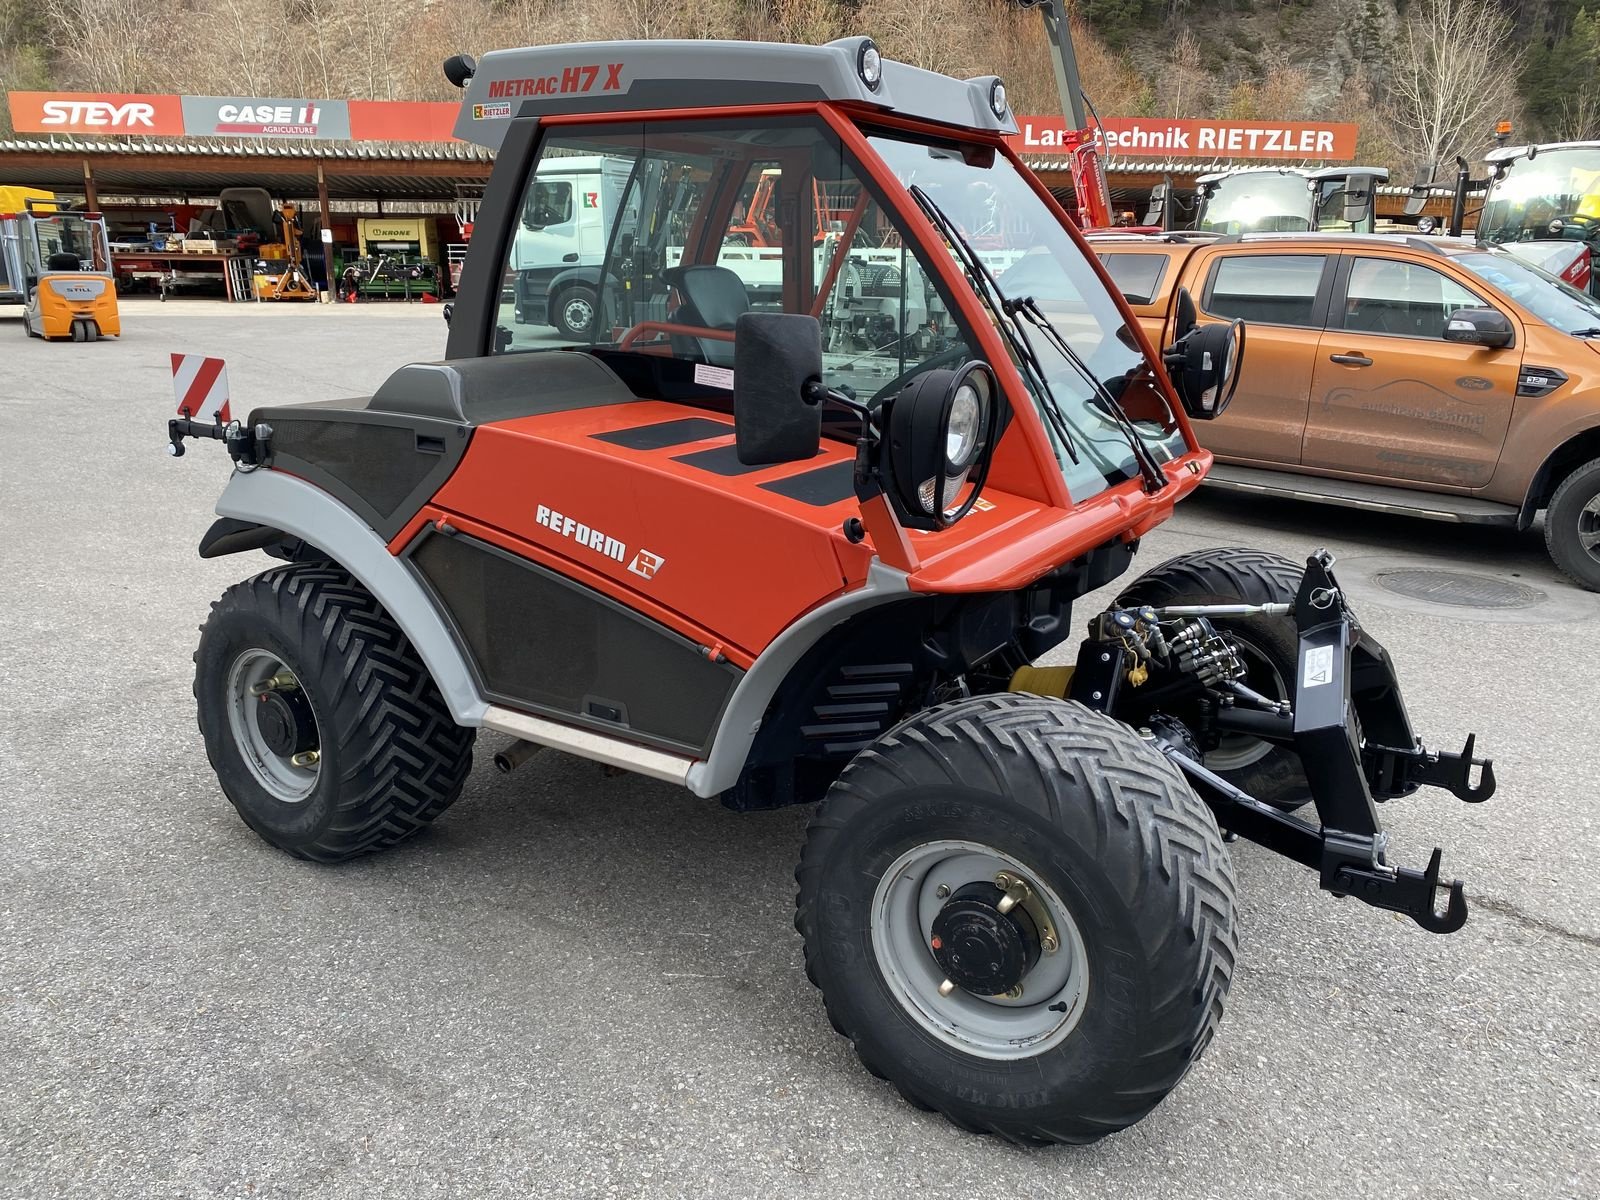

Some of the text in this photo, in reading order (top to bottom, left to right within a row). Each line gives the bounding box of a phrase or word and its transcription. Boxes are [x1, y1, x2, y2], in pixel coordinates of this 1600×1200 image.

[488, 63, 624, 98] METRAC H7 X
[40, 100, 155, 127] STEYR
[218, 105, 293, 124] CASE
[484, 108, 510, 116] RIETZLER
[262, 125, 314, 134] AGRICULTURE
[1024, 124, 1334, 152] Latechnik RIETZLER
[1092, 154, 1106, 207] WEIDEMANN
[535, 504, 626, 563] REFORM
